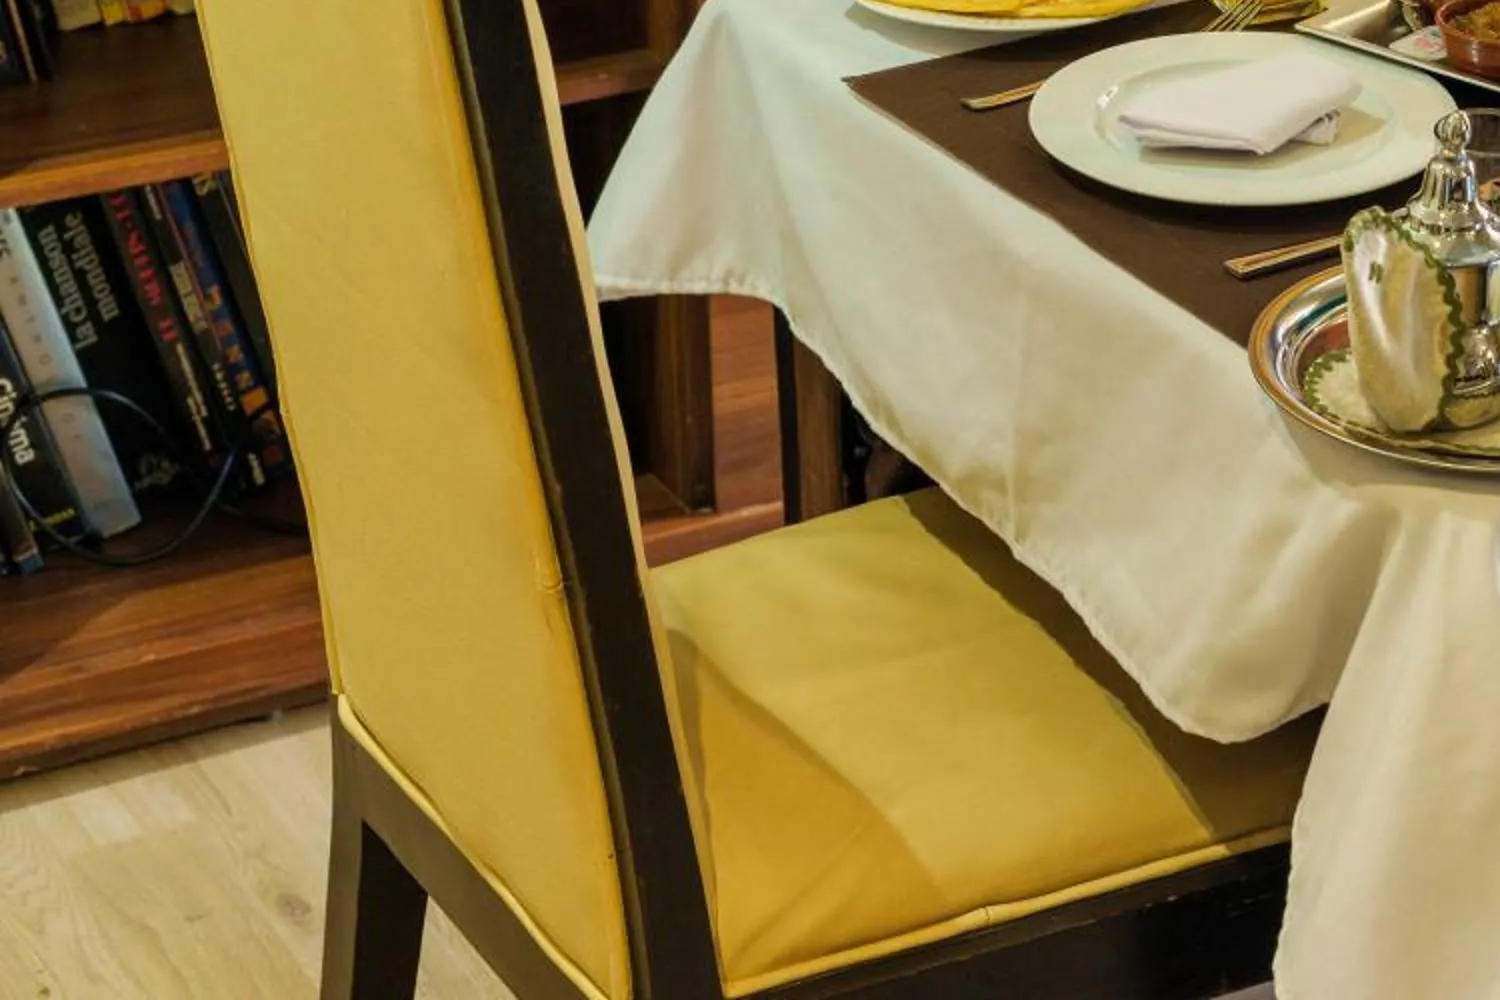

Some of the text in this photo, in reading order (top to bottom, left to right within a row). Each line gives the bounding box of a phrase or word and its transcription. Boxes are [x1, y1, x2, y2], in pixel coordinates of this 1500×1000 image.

[37, 225, 98, 349] la chanson
[64, 212, 120, 322] mondiale
[0, 378, 35, 466] Cinma
